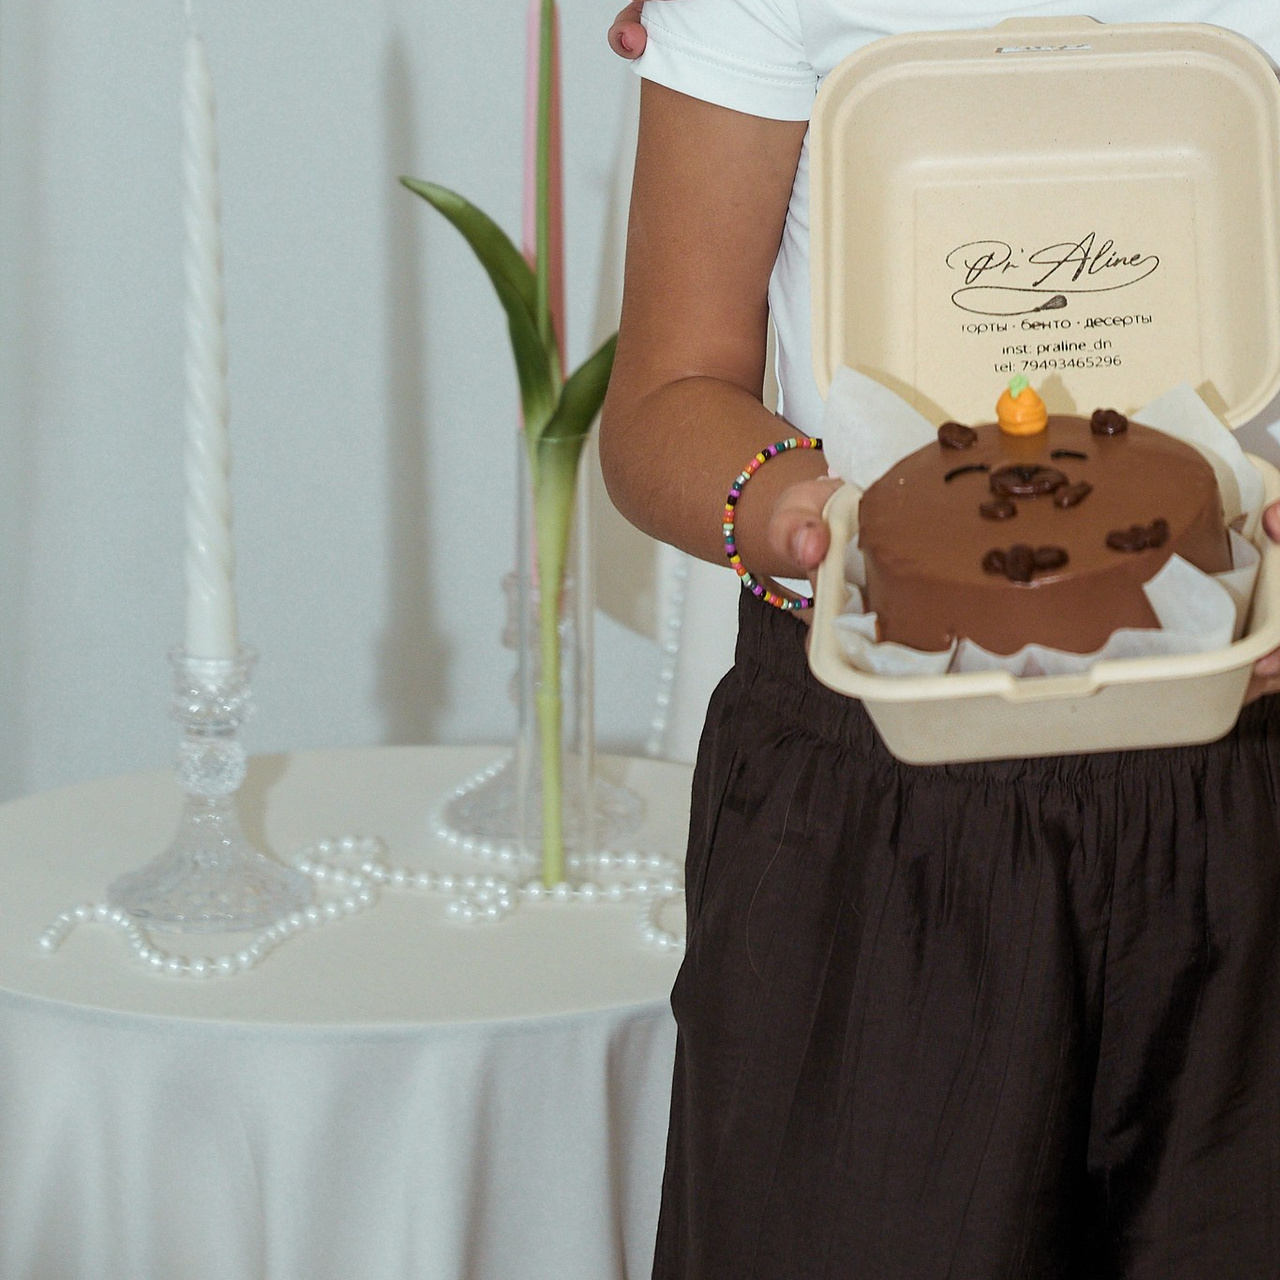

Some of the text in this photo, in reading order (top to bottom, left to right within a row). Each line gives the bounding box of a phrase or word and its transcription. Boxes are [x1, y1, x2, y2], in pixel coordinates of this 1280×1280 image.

[1021, 318, 1072, 332] бенто
[1084, 314, 1152, 328] десерты
[1036, 339, 1112, 356] praline_dn
[994, 355, 1122, 373] tel: 79493465296
